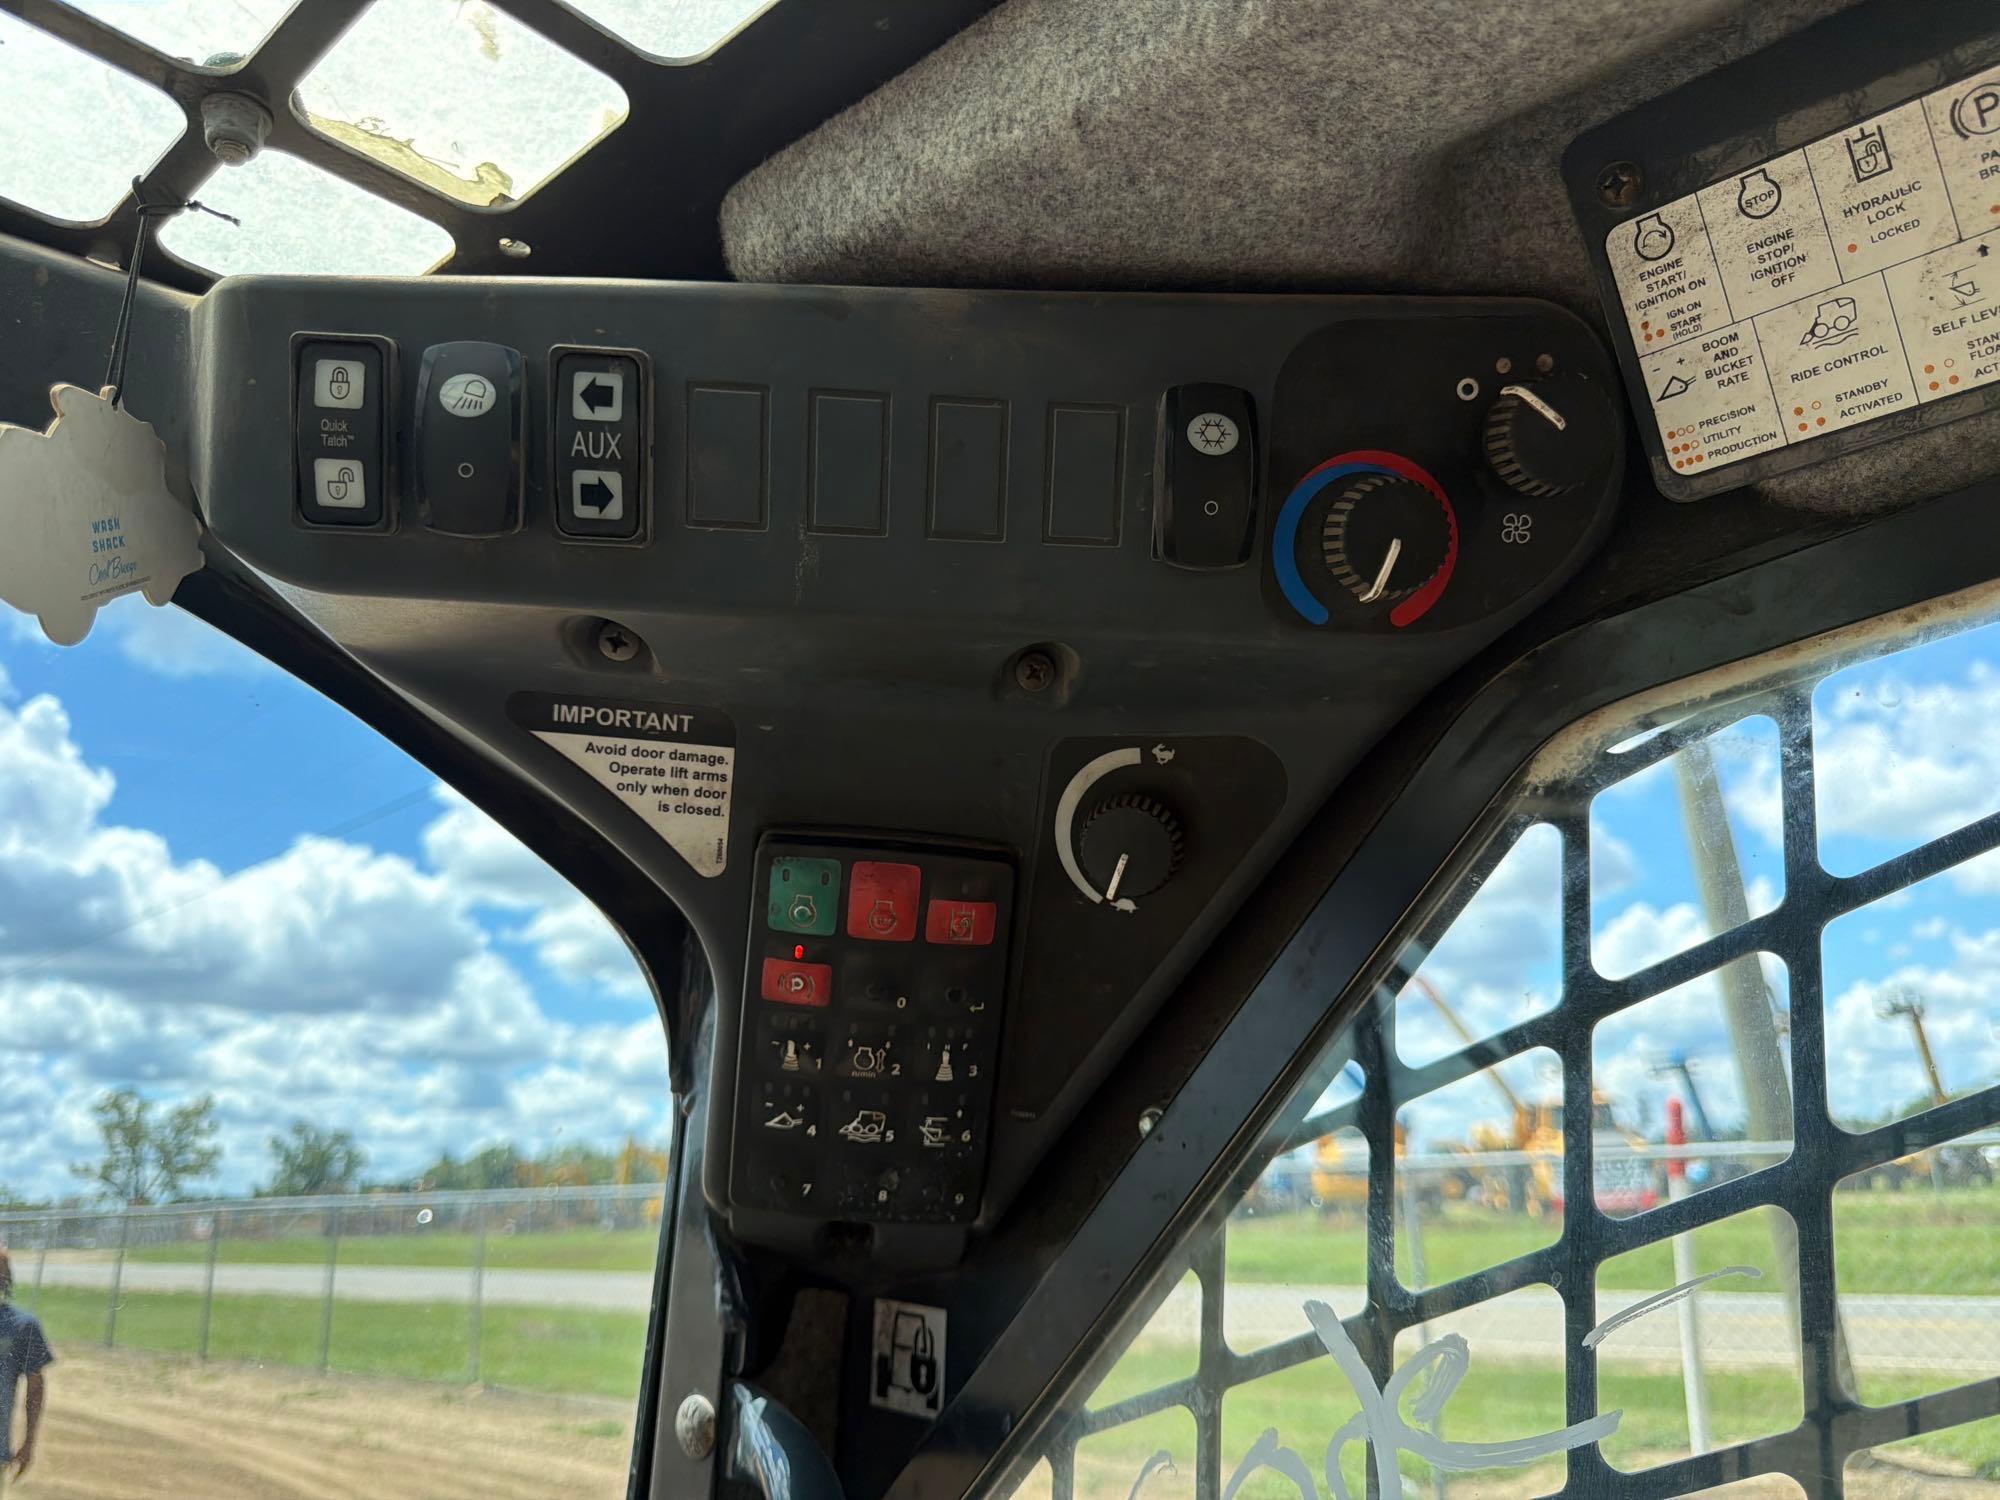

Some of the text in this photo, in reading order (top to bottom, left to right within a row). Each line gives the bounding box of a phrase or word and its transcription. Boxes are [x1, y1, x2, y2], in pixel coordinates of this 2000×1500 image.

[1745, 189, 1775, 208] STOP
[1843, 181, 1922, 218] HYDRAULIC
[1867, 201, 1906, 225] LOCK
[1746, 228, 1795, 254] ENGINE
[1870, 219, 1920, 244] LOCKED
[1757, 243, 1795, 265] STOP/
[1639, 258, 1684, 282] ENGINE
[1750, 254, 1807, 282] IGNITION
[1646, 270, 1687, 293] START/
[1771, 272, 1796, 289] OFF
[1635, 277, 1706, 311] IGNITION ON
[1666, 300, 1702, 320] IGN ON
[1670, 313, 1702, 332] START
[1672, 323, 1703, 341] (HOLD)
[1932, 316, 1968, 336] SELF
[1702, 332, 1739, 353] BOOM
[1713, 347, 1739, 363] AND
[1790, 345, 1889, 383] RIDE CONTROL
[1705, 355, 1754, 380] BUCKET
[1717, 371, 1750, 389] RATE
[1834, 378, 1889, 403] STANDBY
[1839, 392, 1903, 419] ACTIVATED
[1698, 404, 1756, 429] PRECISION
[570, 431, 622, 460] AUX
[1703, 426, 1741, 445] UTILITY
[1707, 431, 1778, 459] PRODUCTION
[91, 517, 121, 534] WASH
[92, 535, 126, 553] SHACK
[552, 703, 694, 733] IMPORTANT
[585, 741, 729, 767] Avoid door damage.
[609, 761, 728, 783] Operate lift arms
[616, 780, 727, 800] only when door
[658, 800, 725, 817] is closed.
[815, 1058, 823, 1072] 1
[891, 1064, 901, 1076] 2
[968, 1064, 978, 1077] 3
[806, 1124, 817, 1137] 4
[885, 1129, 895, 1142] 5
[961, 1129, 971, 1142] 6
[802, 1183, 812, 1196] 7
[878, 1190, 888, 1201] 8
[955, 1193, 964, 1205] 9
